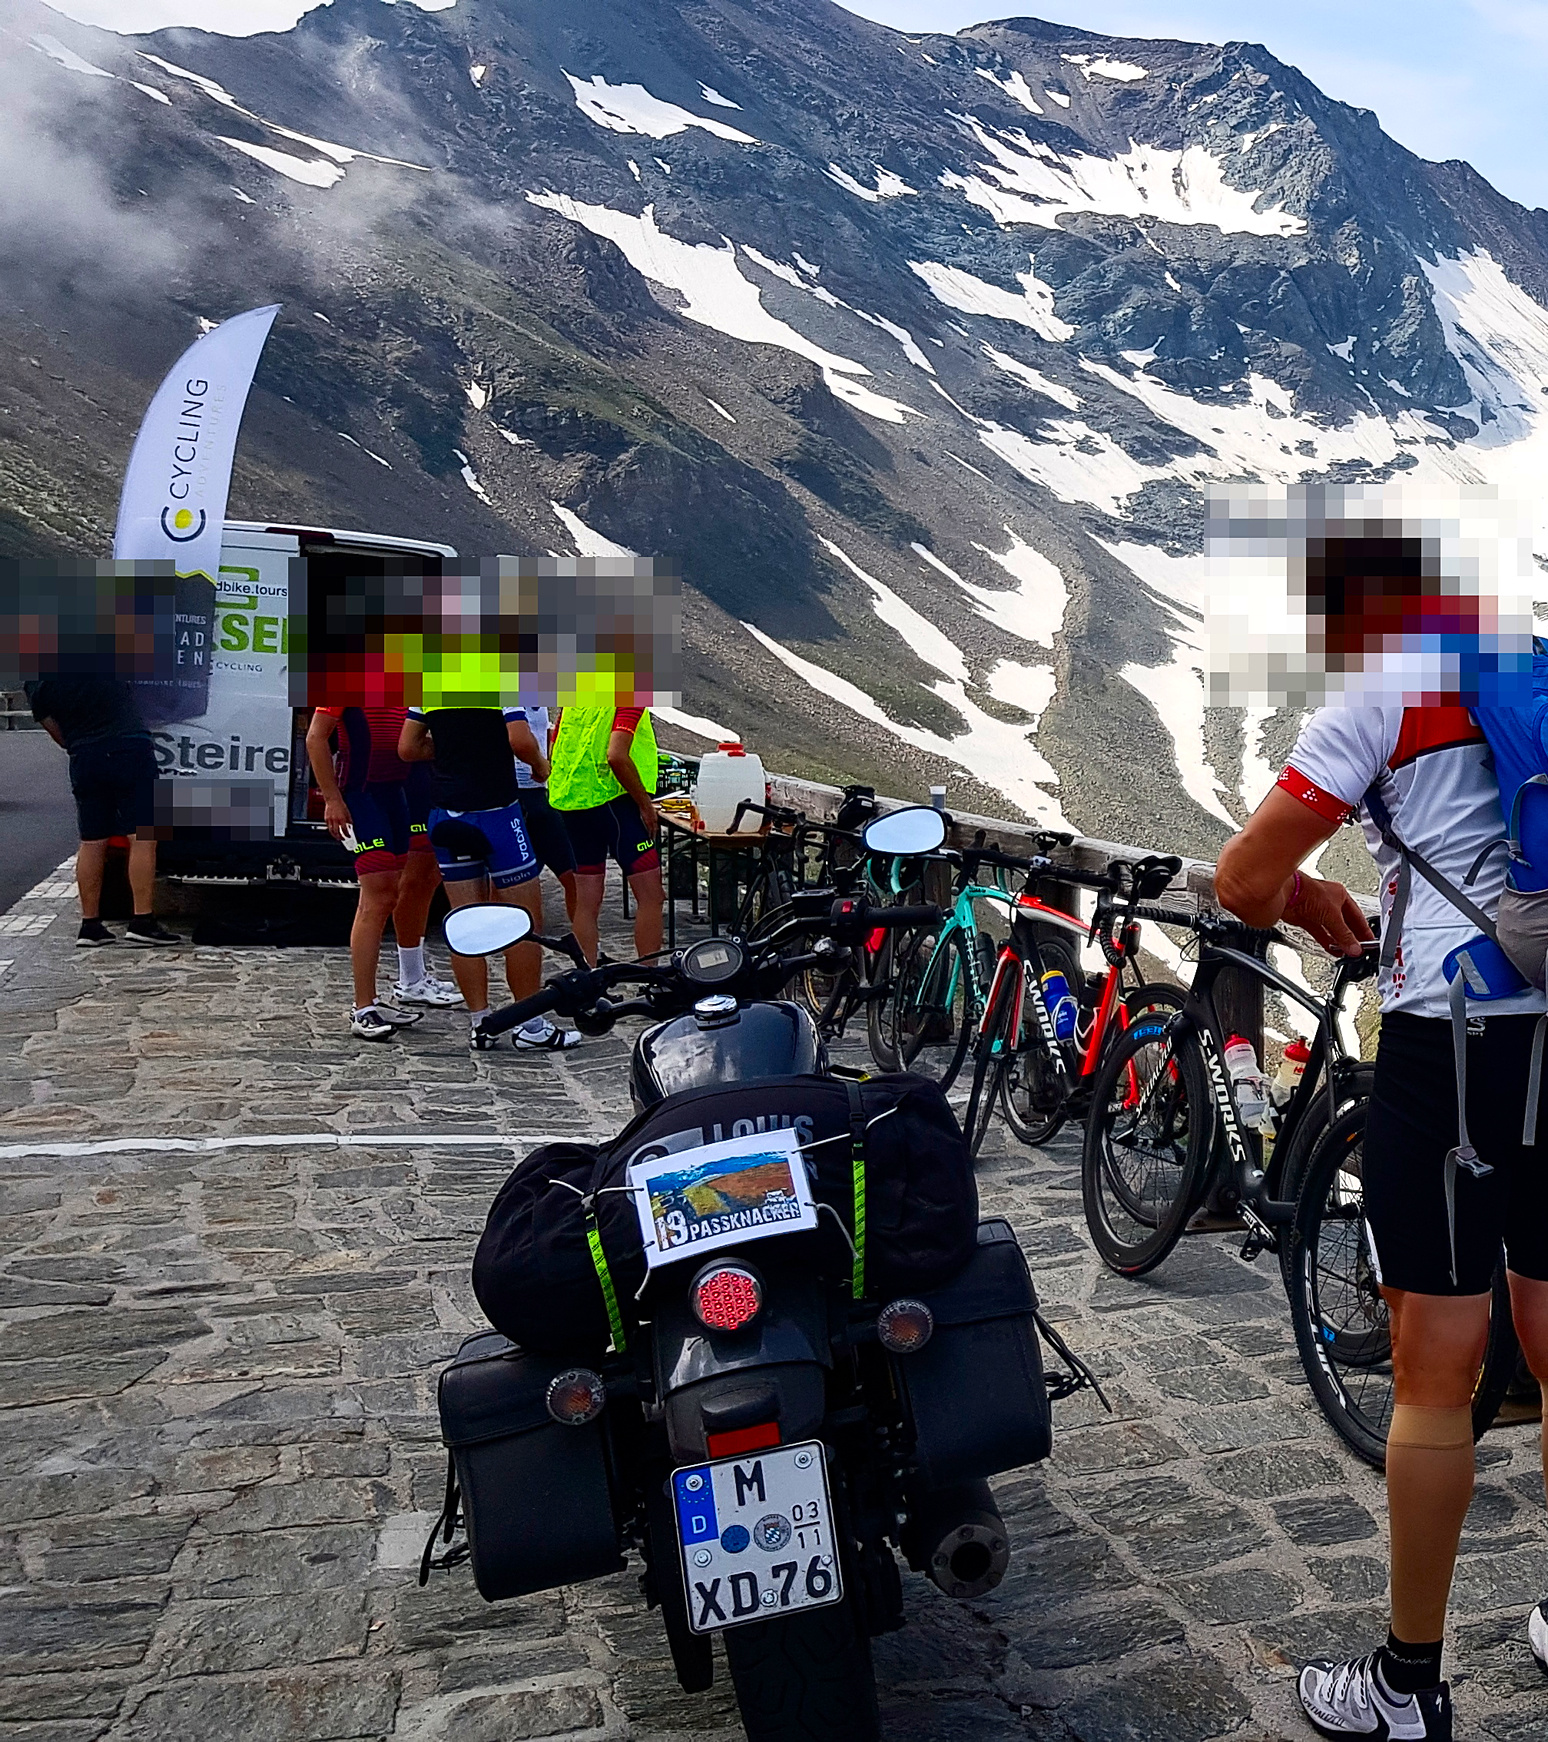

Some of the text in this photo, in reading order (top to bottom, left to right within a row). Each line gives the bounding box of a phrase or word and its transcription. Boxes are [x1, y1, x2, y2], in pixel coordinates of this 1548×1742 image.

[169, 379, 209, 500] CYCLING
[174, 613, 207, 625] NTURES
[216, 661, 263, 673] CYCLING
[1198, 1028, 1247, 1162] S-WORKS
[690, 1201, 802, 1241] PASSKNACKER
[733, 1459, 767, 1507] M
[691, 1515, 707, 1535] D
[791, 1501, 820, 1522] 03
[797, 1528, 821, 1549] 11
[694, 1555, 833, 1626] XD 76
